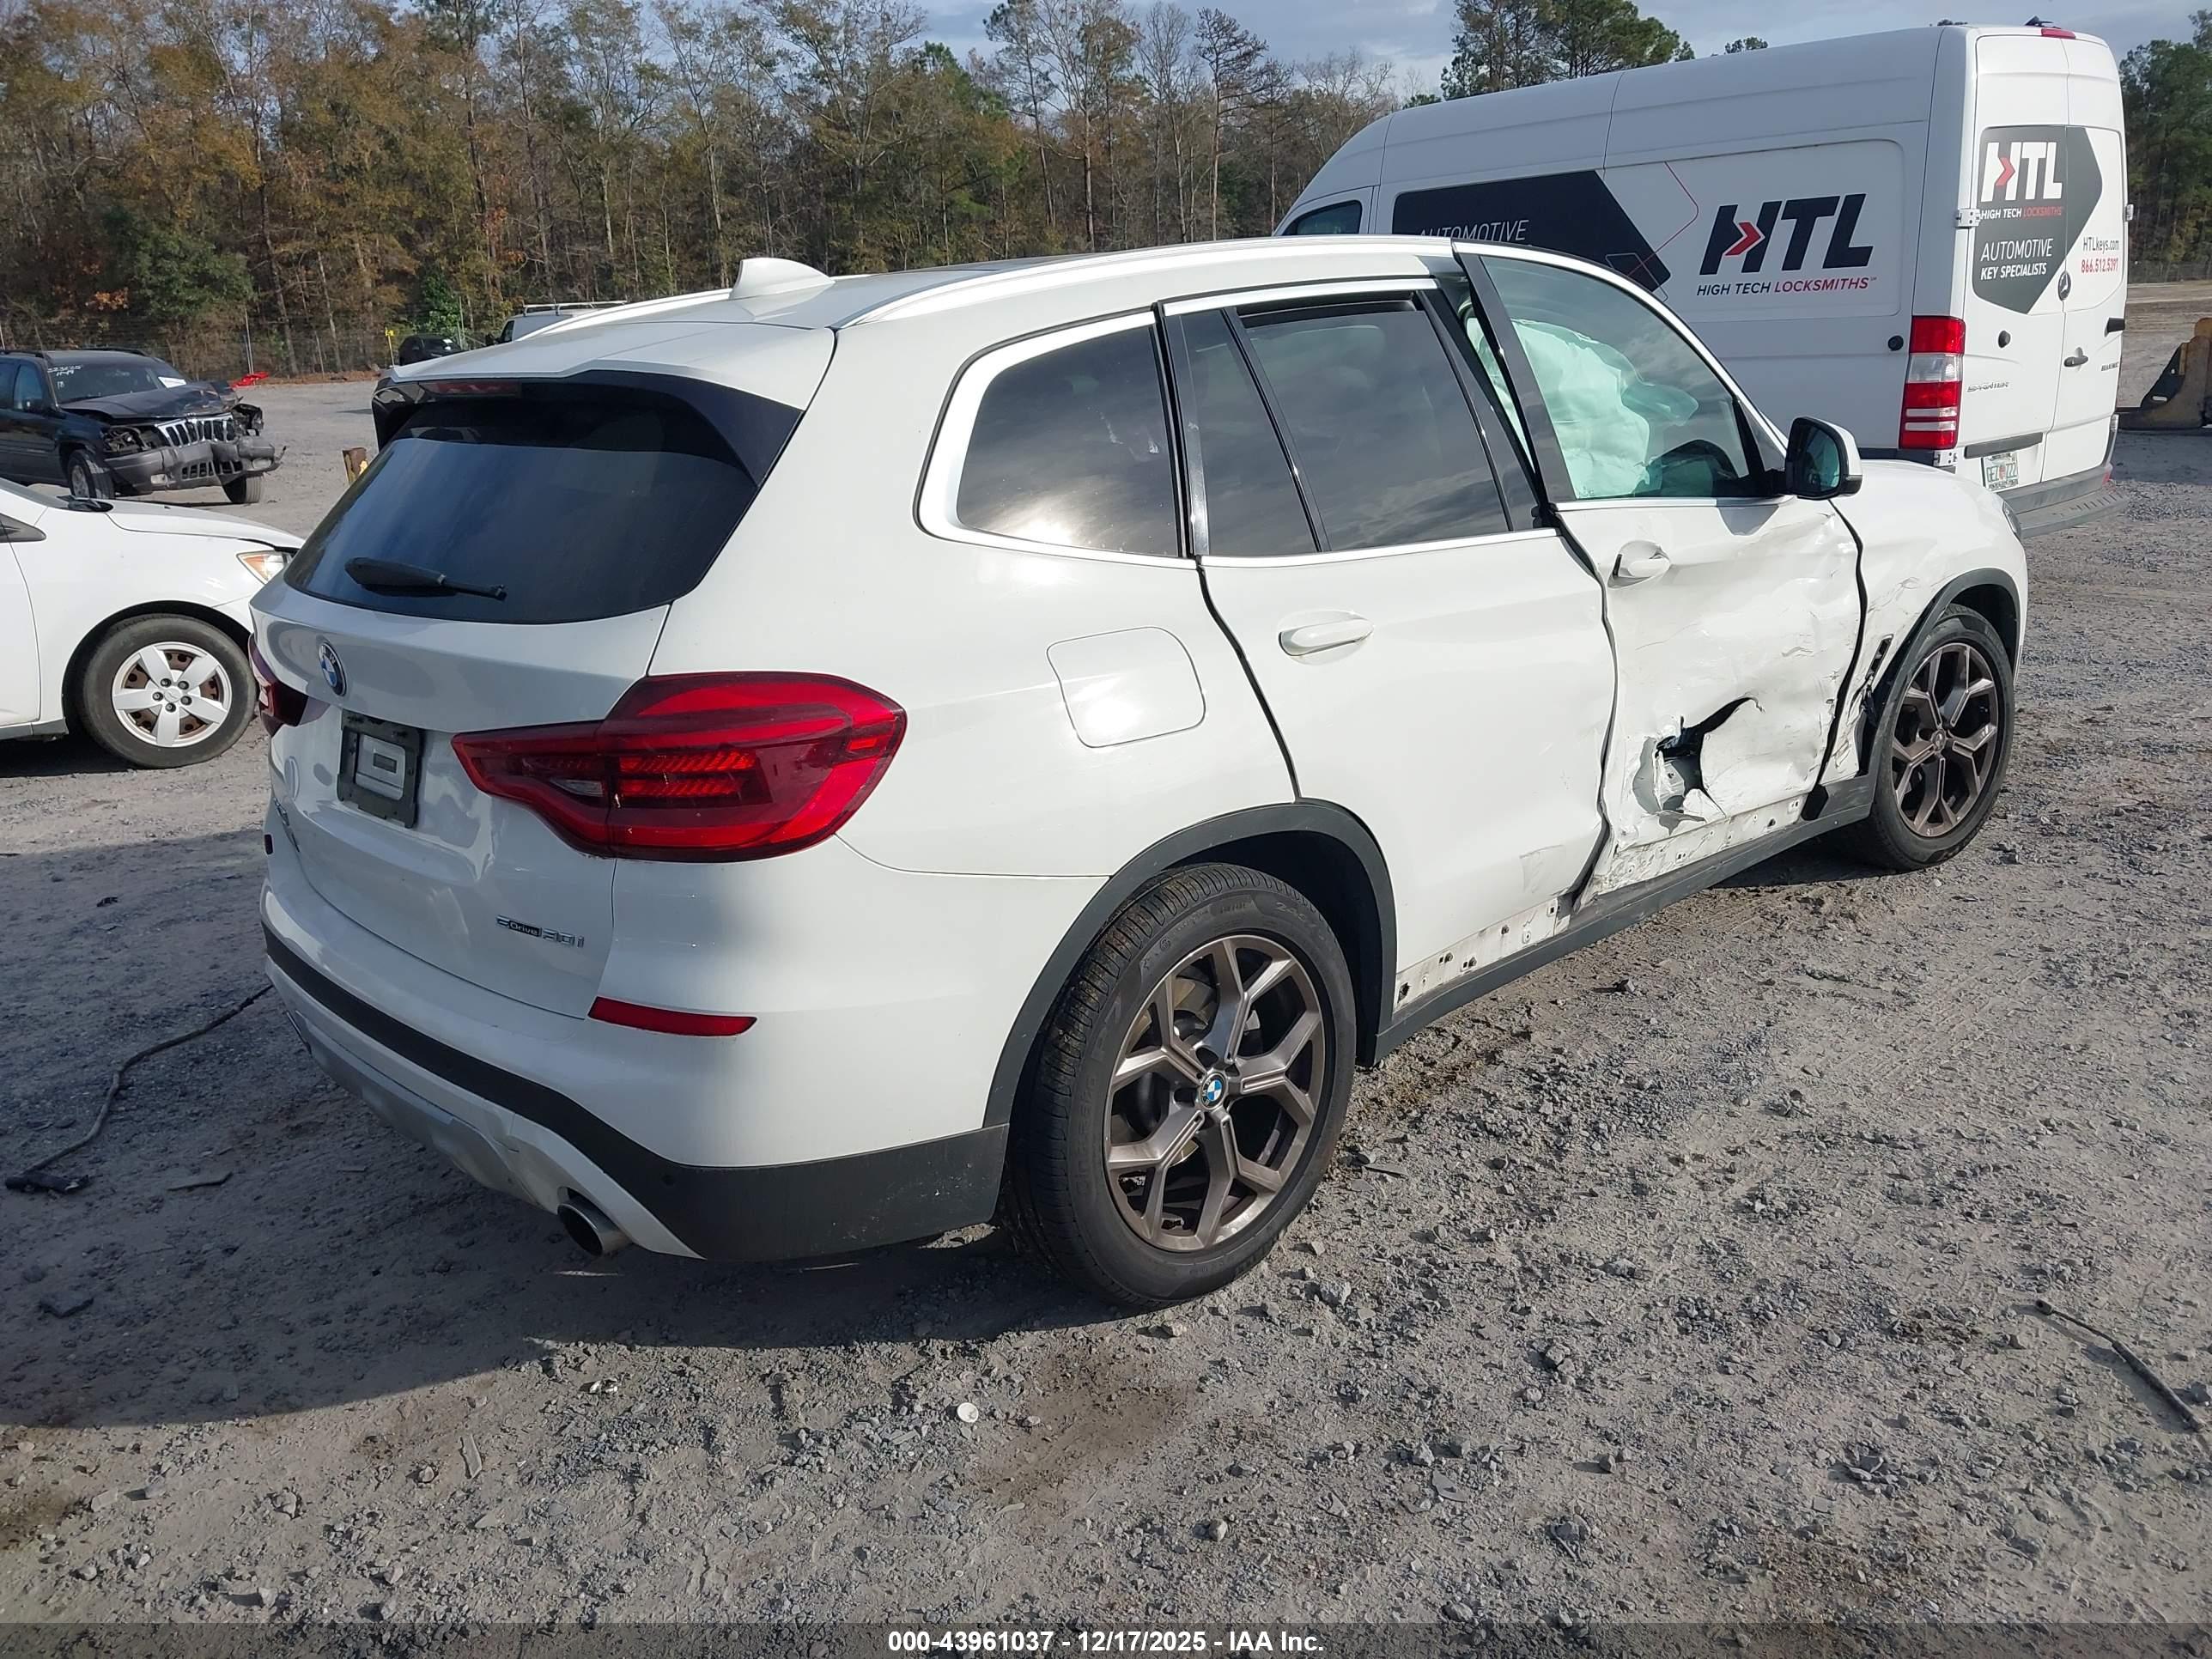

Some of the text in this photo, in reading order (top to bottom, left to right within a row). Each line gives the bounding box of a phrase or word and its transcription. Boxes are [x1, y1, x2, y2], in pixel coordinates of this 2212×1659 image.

[1980, 142, 2063, 203] HTL
[1980, 210, 2002, 219] HIGH
[2002, 208, 2022, 218] TECH
[1699, 193, 1874, 275] HTL
[1980, 238, 2053, 261] AUTOMOTIVE
[1980, 262, 2047, 281] KEY SPECIALISTS
[1697, 284, 1731, 295] HIGH
[1735, 282, 1771, 295] TECH
[1774, 277, 1869, 293] LOCKSMITHS
